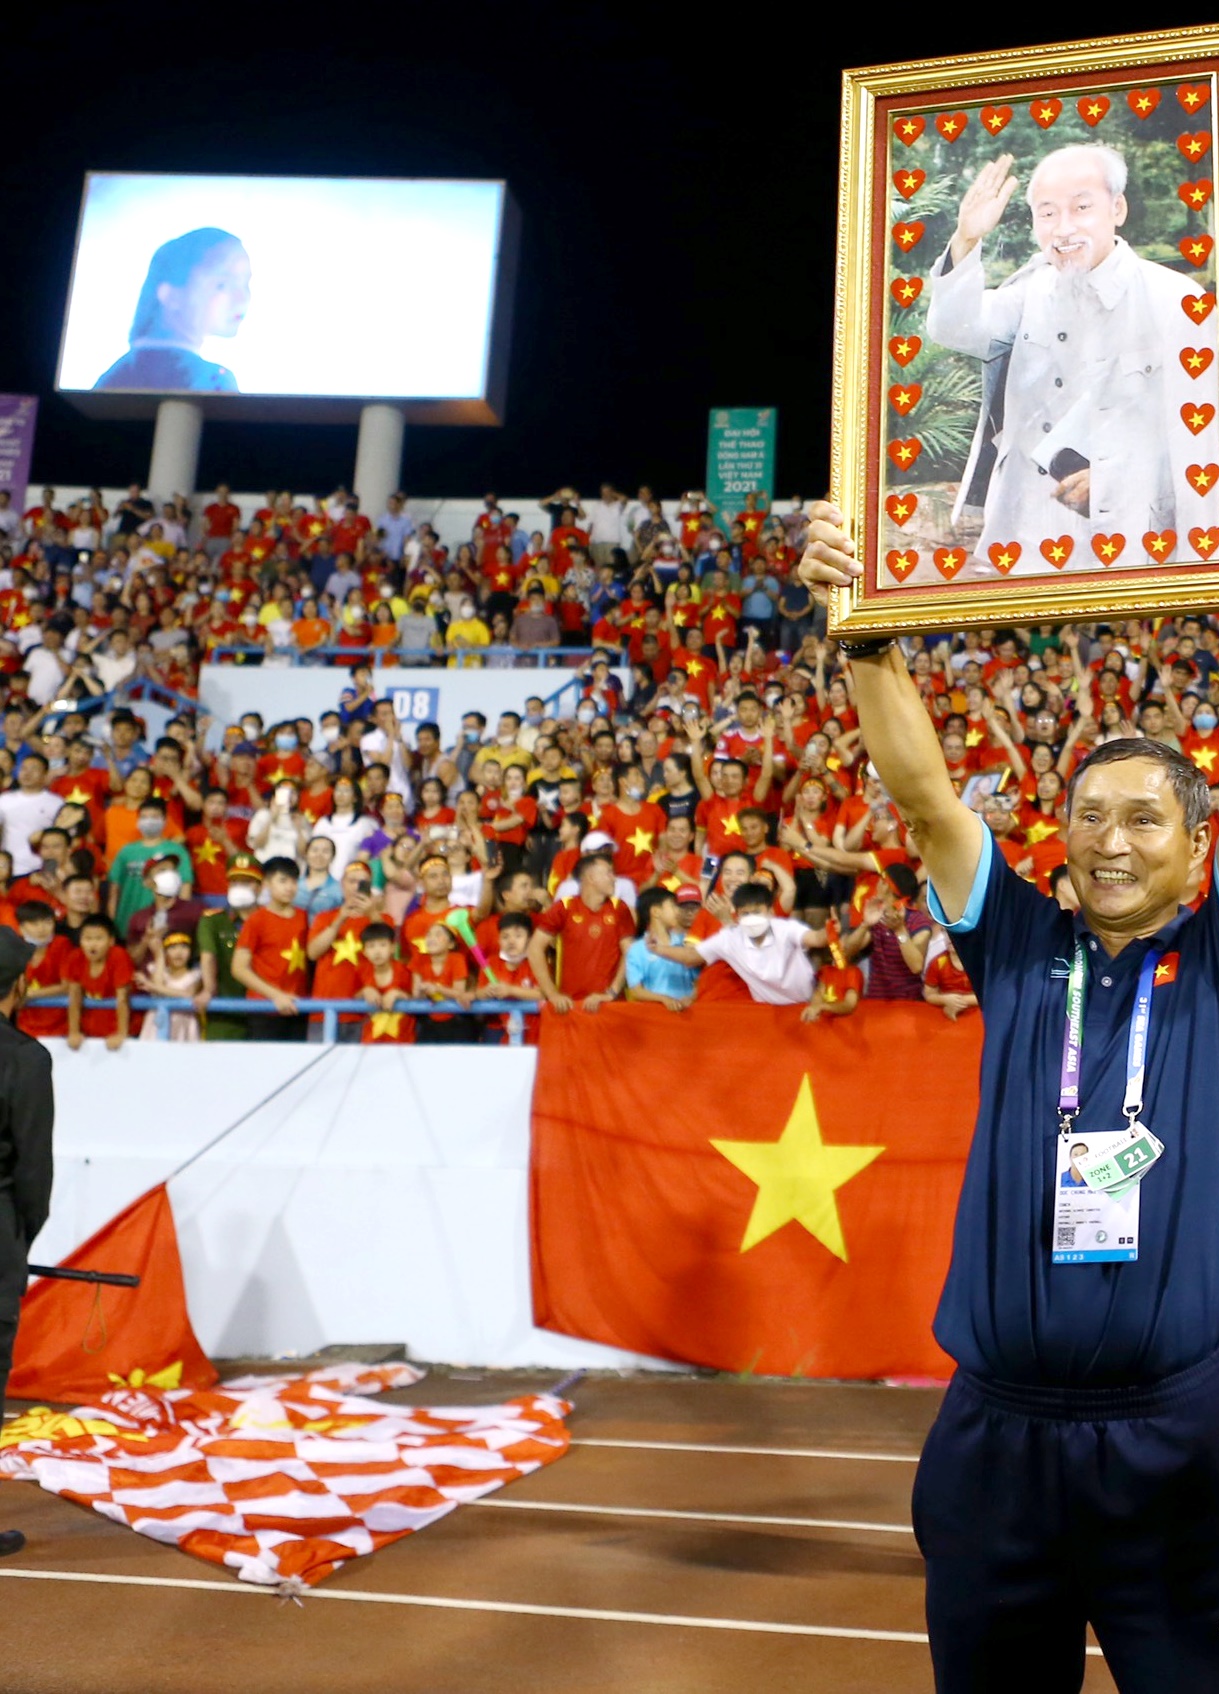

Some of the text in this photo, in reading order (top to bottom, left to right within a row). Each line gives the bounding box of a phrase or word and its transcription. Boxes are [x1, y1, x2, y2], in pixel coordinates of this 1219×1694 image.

[723, 481, 757, 493] 2021
[1066, 1046, 1078, 1073] ASIA
[1123, 1146, 1148, 1168] 21
[1089, 1163, 1112, 1178] ZONE
